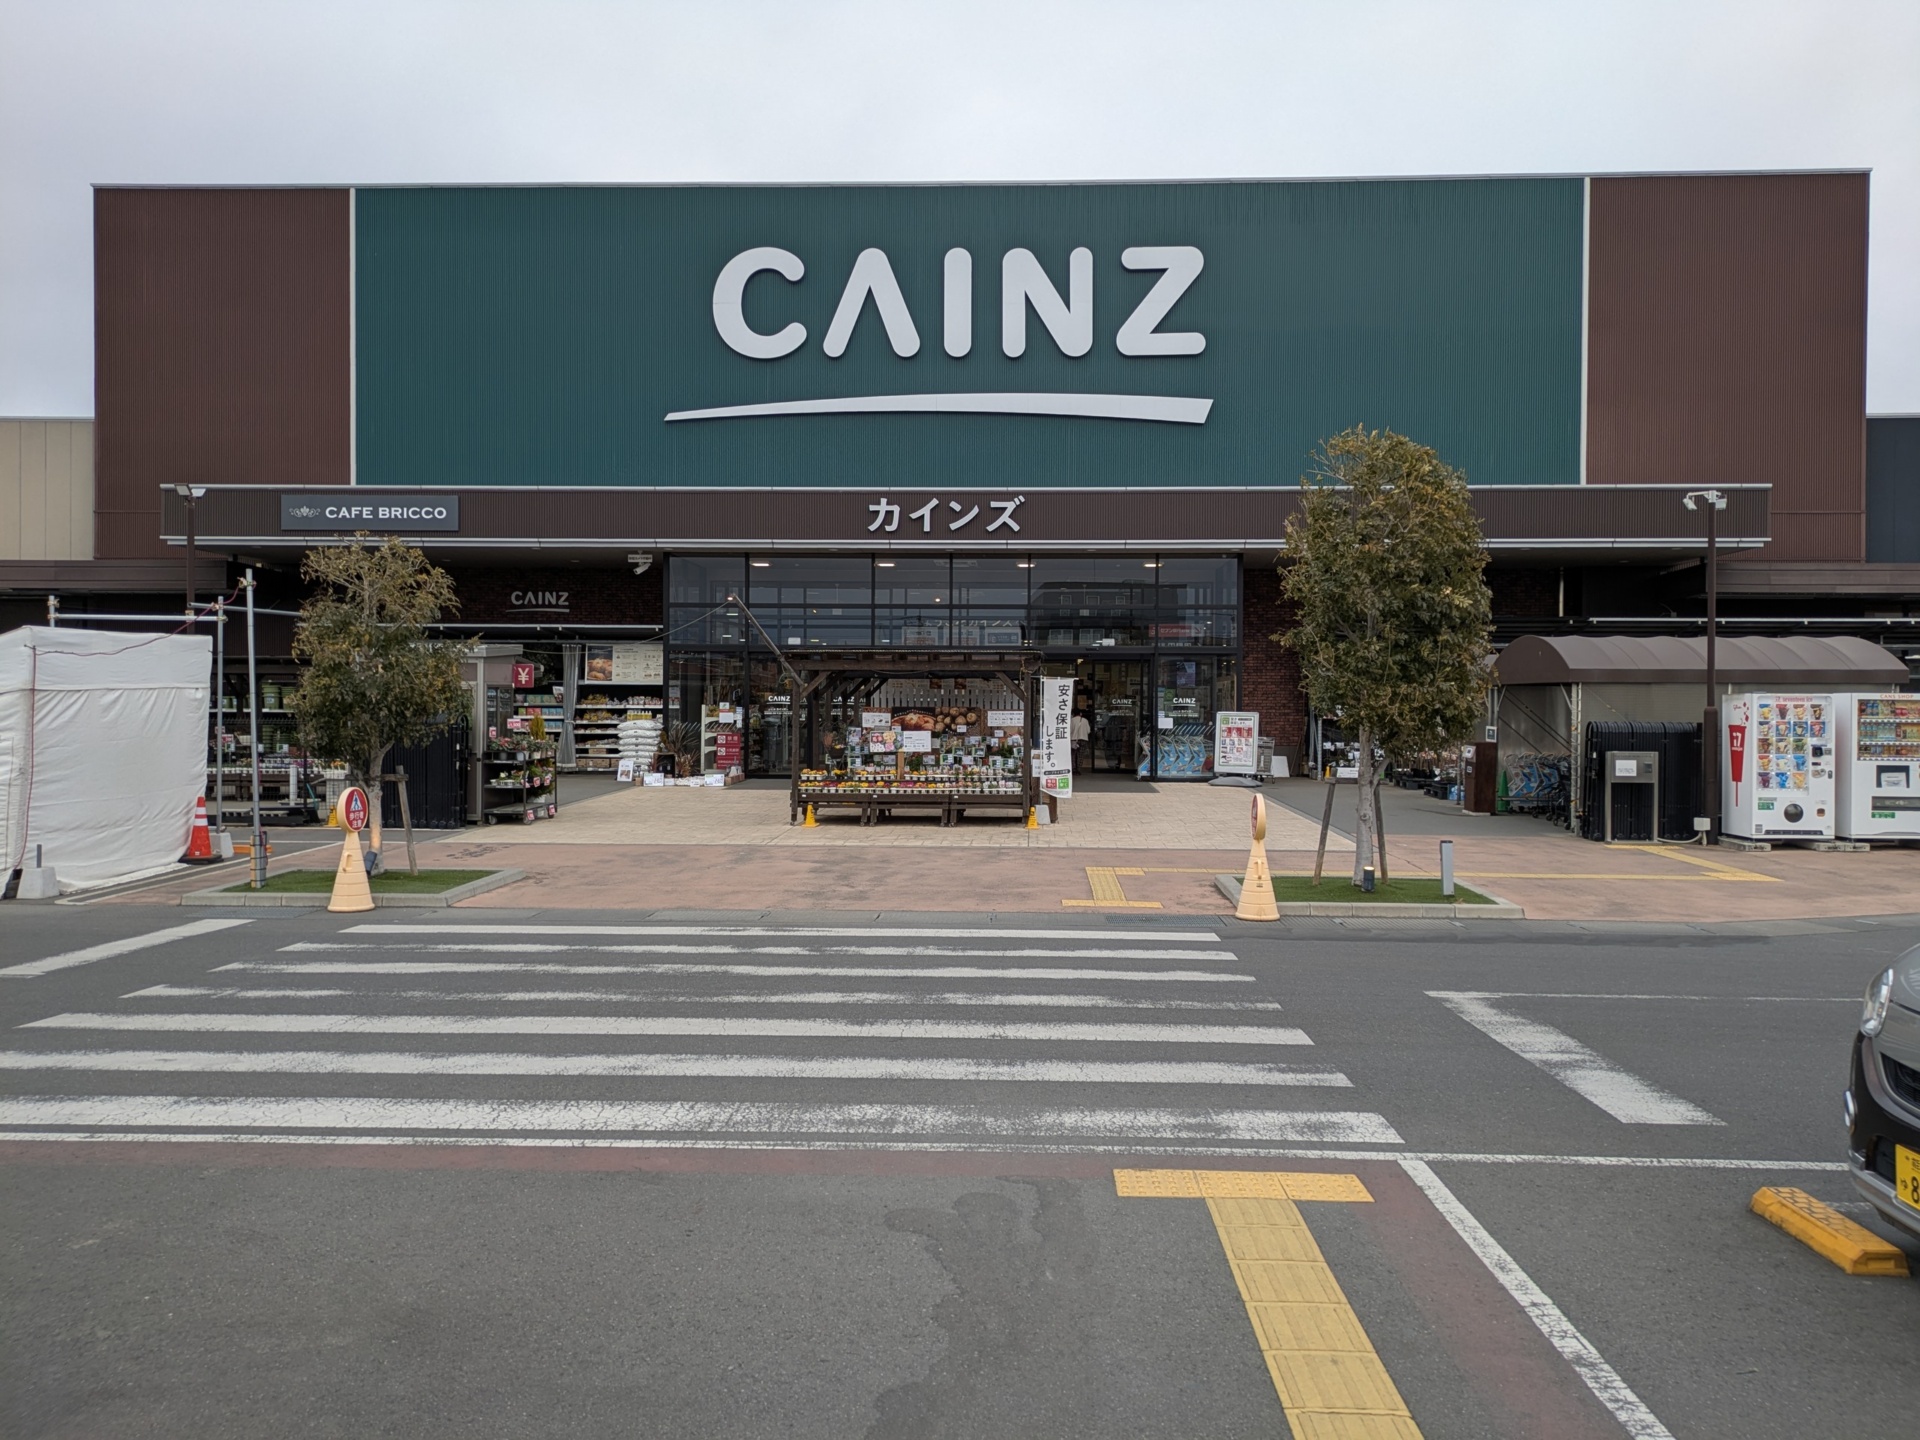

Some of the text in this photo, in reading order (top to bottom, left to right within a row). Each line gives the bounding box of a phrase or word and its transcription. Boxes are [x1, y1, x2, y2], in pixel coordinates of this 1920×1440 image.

[712, 246, 1207, 359] CAINZ
[325, 506, 447, 520] CAFE BRICCO
[867, 495, 1026, 533] カインズ
[510, 591, 570, 607] CAINZ
[1055, 684, 1070, 740] 安さ保証
[1045, 725, 1056, 768] します。
